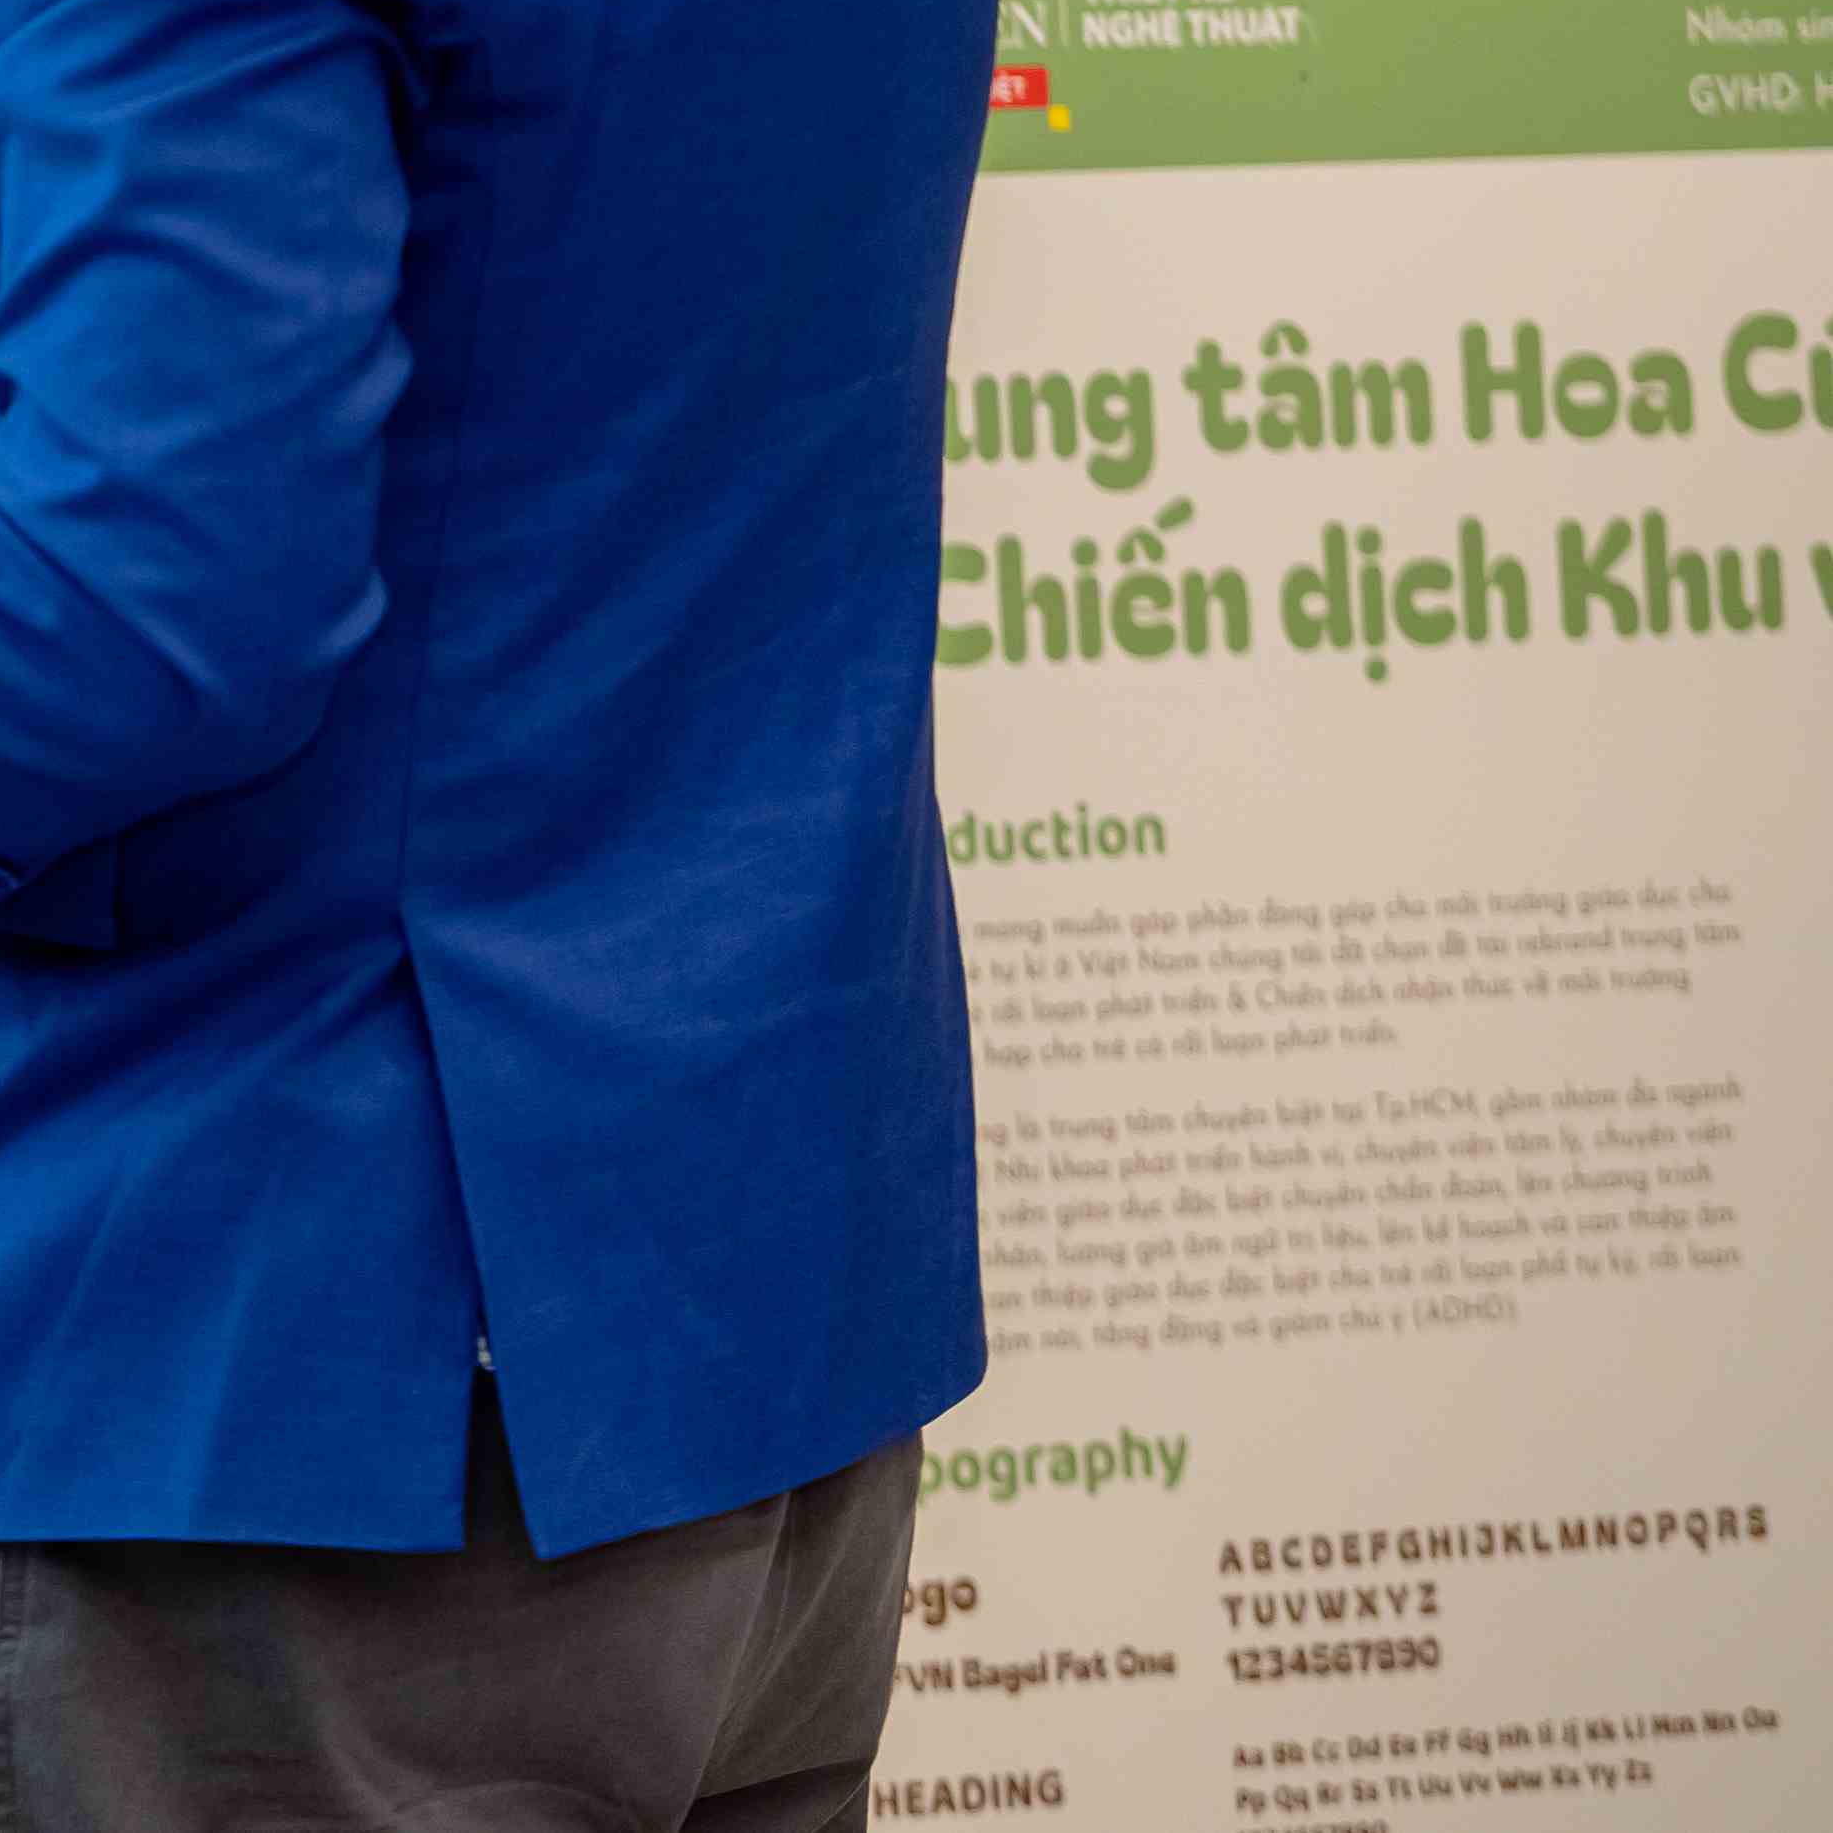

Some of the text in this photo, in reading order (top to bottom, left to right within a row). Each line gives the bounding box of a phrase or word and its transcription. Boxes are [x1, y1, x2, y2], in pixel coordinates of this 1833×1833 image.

[1180, 316, 1434, 455] tâm
[1459, 316, 1696, 445] Hoa
[1279, 516, 1531, 684] dịch
[1556, 506, 1785, 641] Khu
[946, 800, 1169, 866] duction
[919, 1426, 1189, 1505] pography
[893, 1660, 953, 1694] VN
[1226, 1636, 1442, 1683] 1234567890
[871, 1769, 1064, 1819] HEADING
